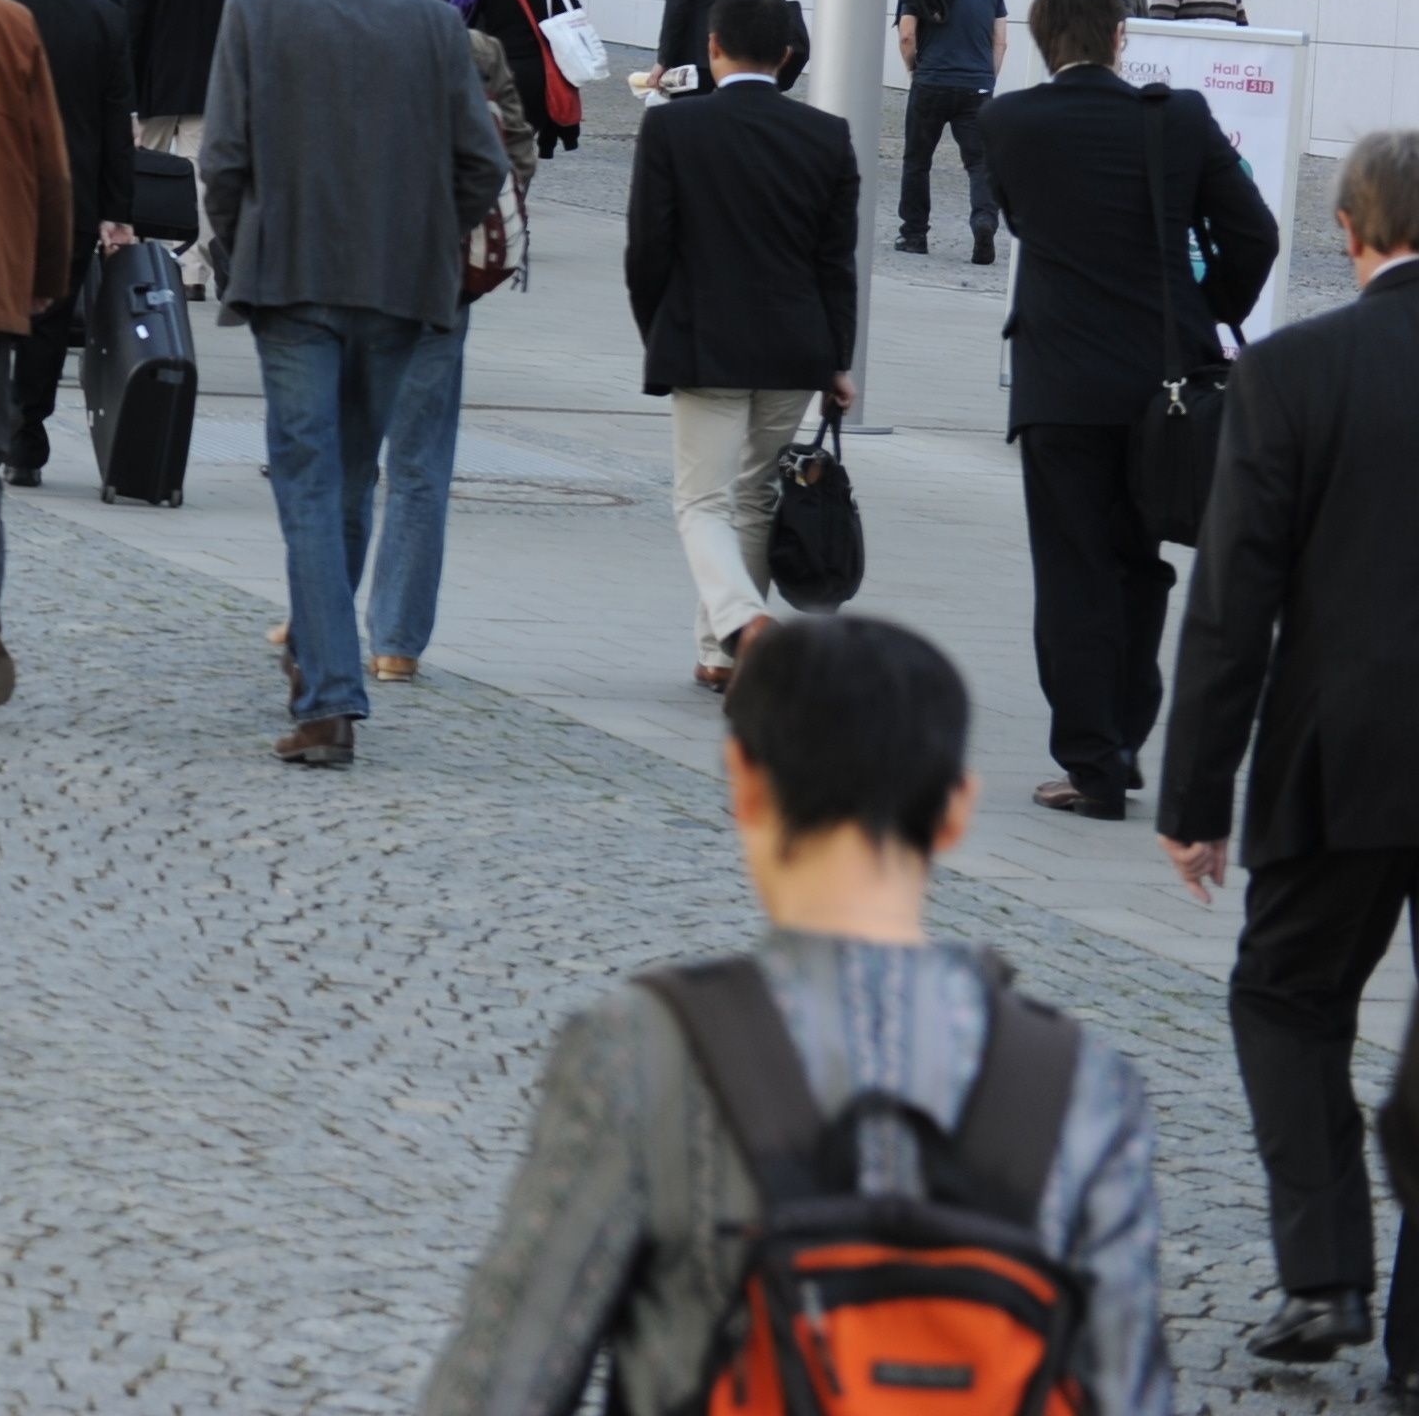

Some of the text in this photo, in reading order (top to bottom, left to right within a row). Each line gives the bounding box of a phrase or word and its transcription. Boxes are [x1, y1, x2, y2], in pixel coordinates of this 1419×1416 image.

[1213, 63, 1262, 78] Hall C1
[1204, 76, 1244, 90] Stand
